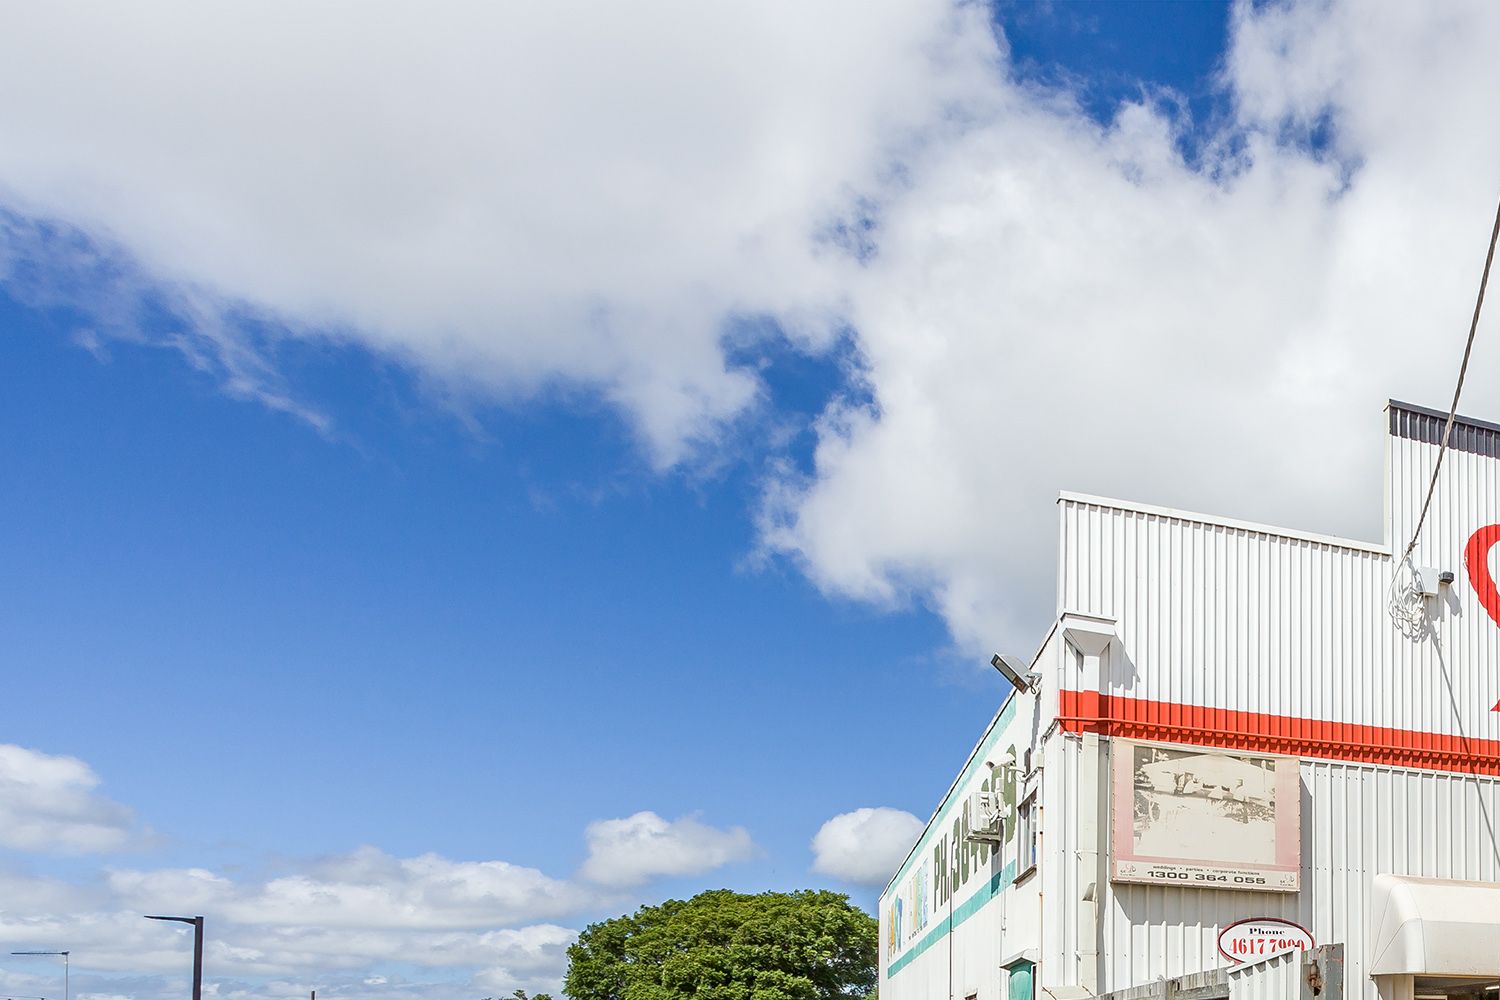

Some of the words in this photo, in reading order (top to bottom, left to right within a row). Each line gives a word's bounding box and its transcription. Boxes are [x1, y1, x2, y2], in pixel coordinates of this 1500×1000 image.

[1147, 871, 1188, 880] 1300
[1195, 873, 1227, 882] 364
[1234, 876, 1266, 885] 055
[1229, 938, 1265, 955] 4617
